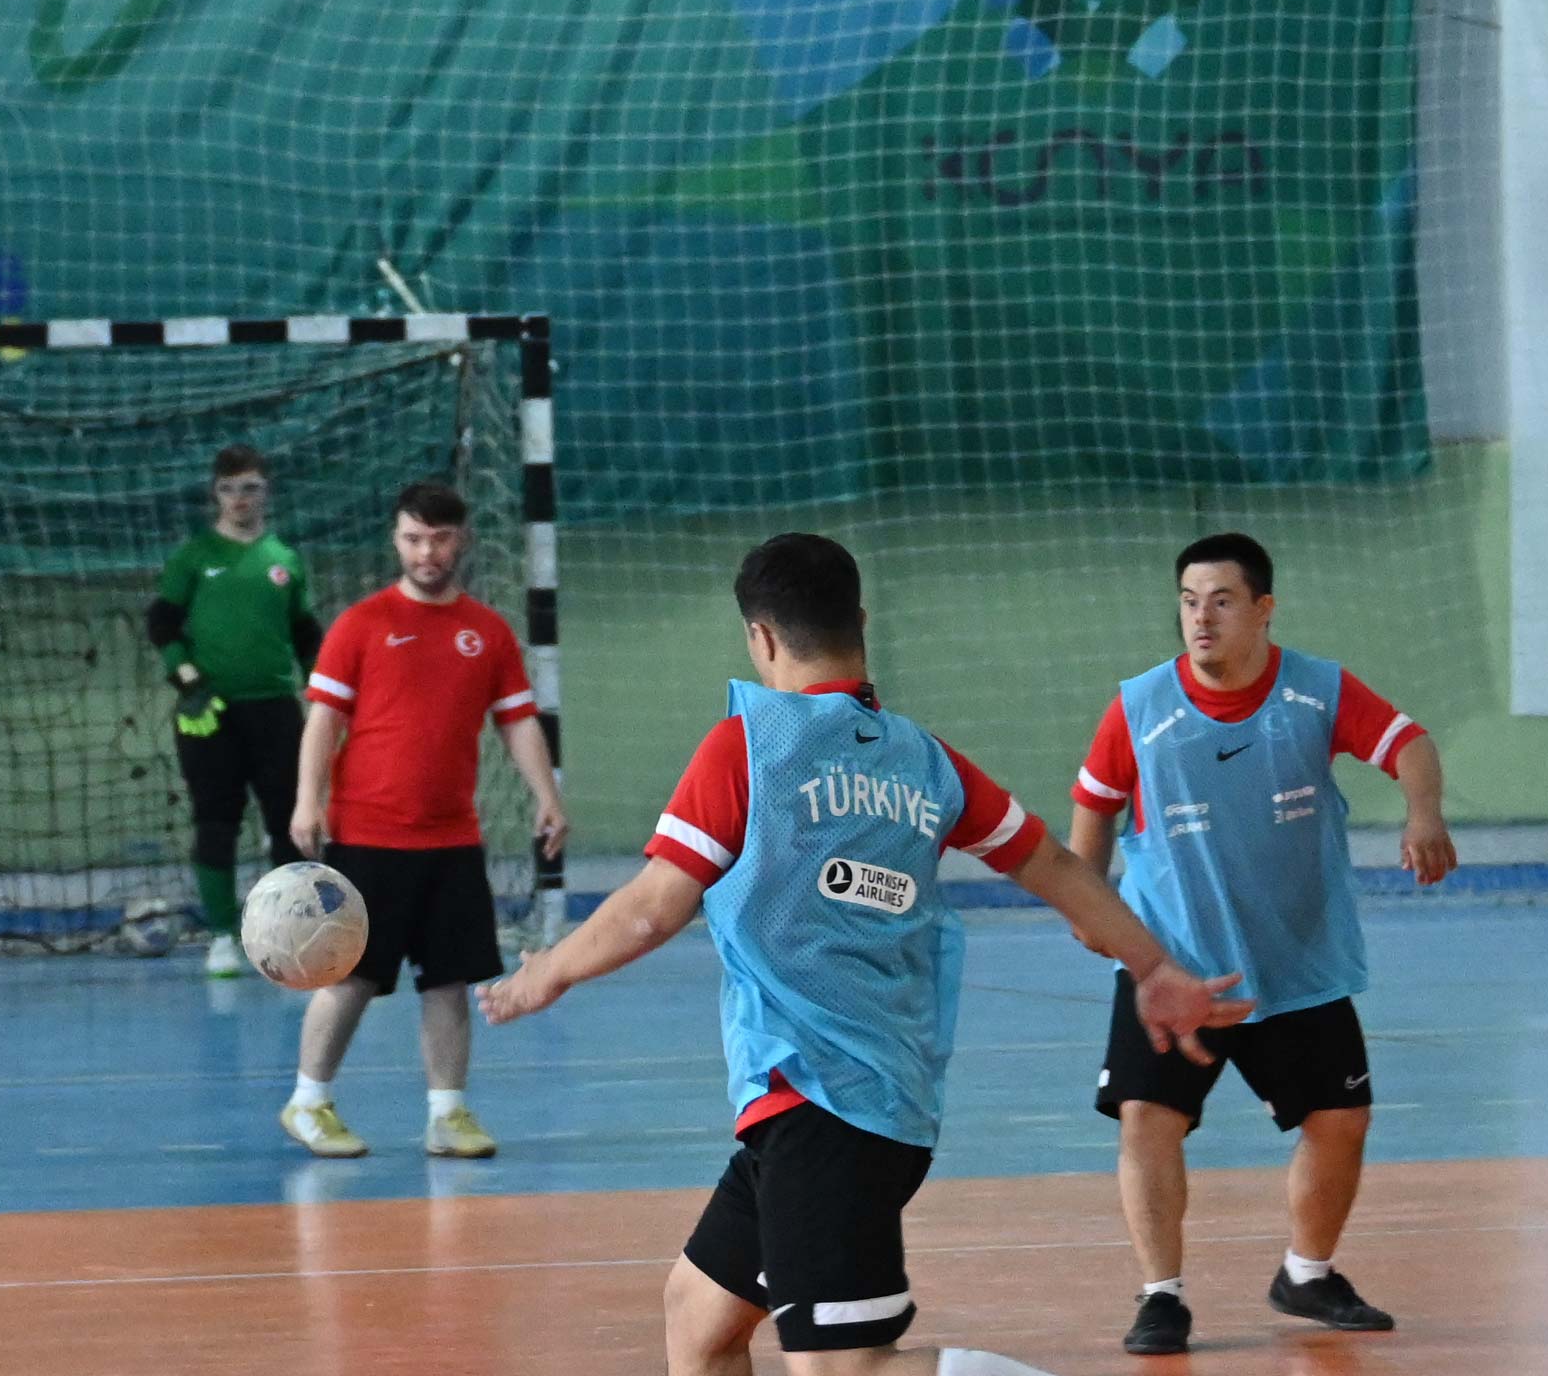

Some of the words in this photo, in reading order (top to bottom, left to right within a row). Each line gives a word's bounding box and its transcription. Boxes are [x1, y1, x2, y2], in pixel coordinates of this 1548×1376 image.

[798, 765, 941, 840] TÜRKİYE
[860, 867, 909, 892] TURKISH
[854, 884, 905, 908] AIRLINES
